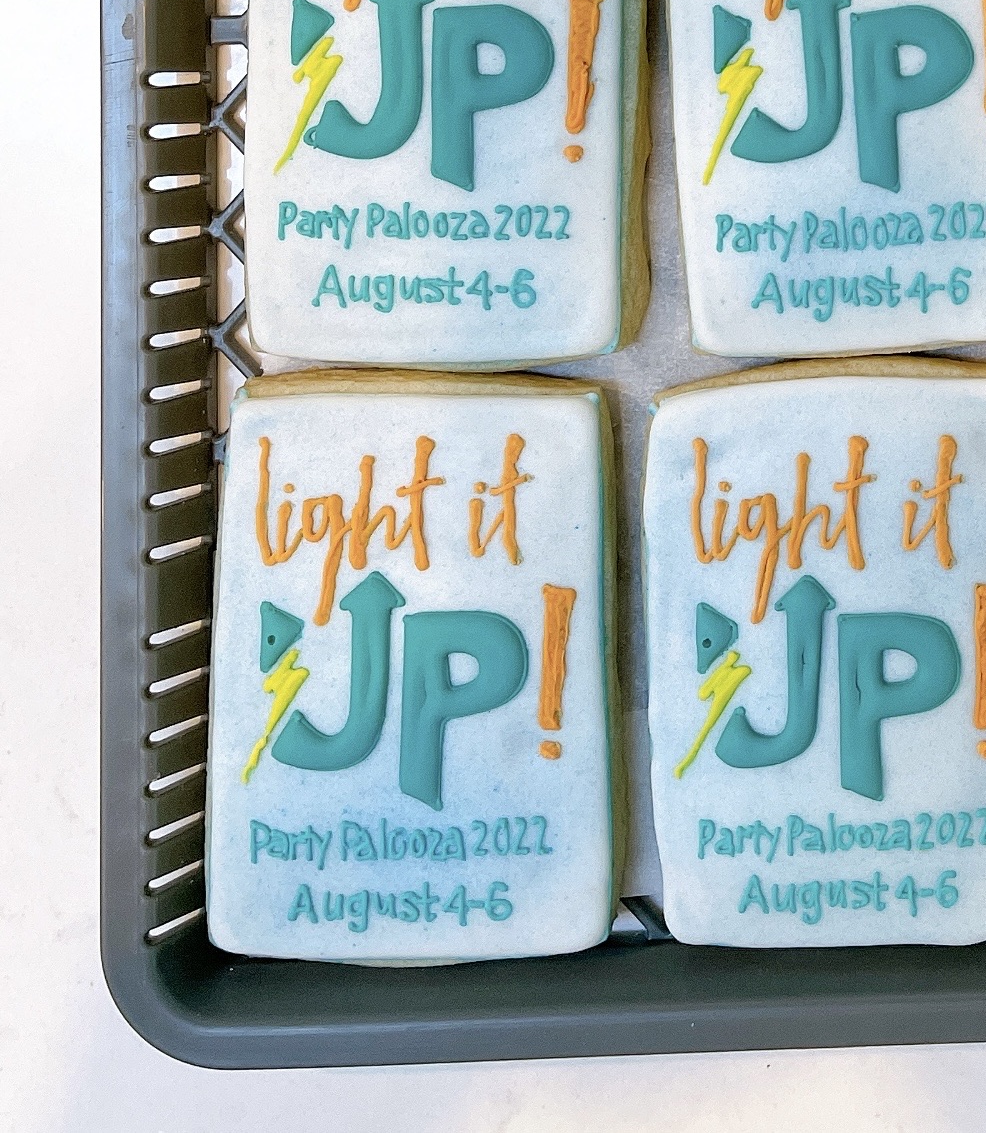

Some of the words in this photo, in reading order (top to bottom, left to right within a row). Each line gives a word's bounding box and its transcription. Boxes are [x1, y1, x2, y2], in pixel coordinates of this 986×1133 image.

[278, 201, 359, 250] Party
[366, 202, 490, 241] Palooza
[494, 204, 570, 240] 2022
[715, 214, 797, 262] Party
[803, 206, 924, 253] Palooza
[311, 264, 464, 314] August
[466, 268, 537, 310] 4-6
[751, 267, 901, 322] August
[905, 267, 972, 314] 4-6
[470, 434, 530, 563] it
[905, 435, 963, 567] it
[249, 818, 332, 870] Party
[339, 817, 467, 862] Palooza
[471, 815, 552, 857] 2022
[698, 818, 781, 863] Party
[787, 813, 912, 857] Palooza
[287, 884, 439, 933] August
[443, 880, 513, 926] 4-6
[738, 871, 889, 925] August
[895, 869, 958, 917] 4-6
